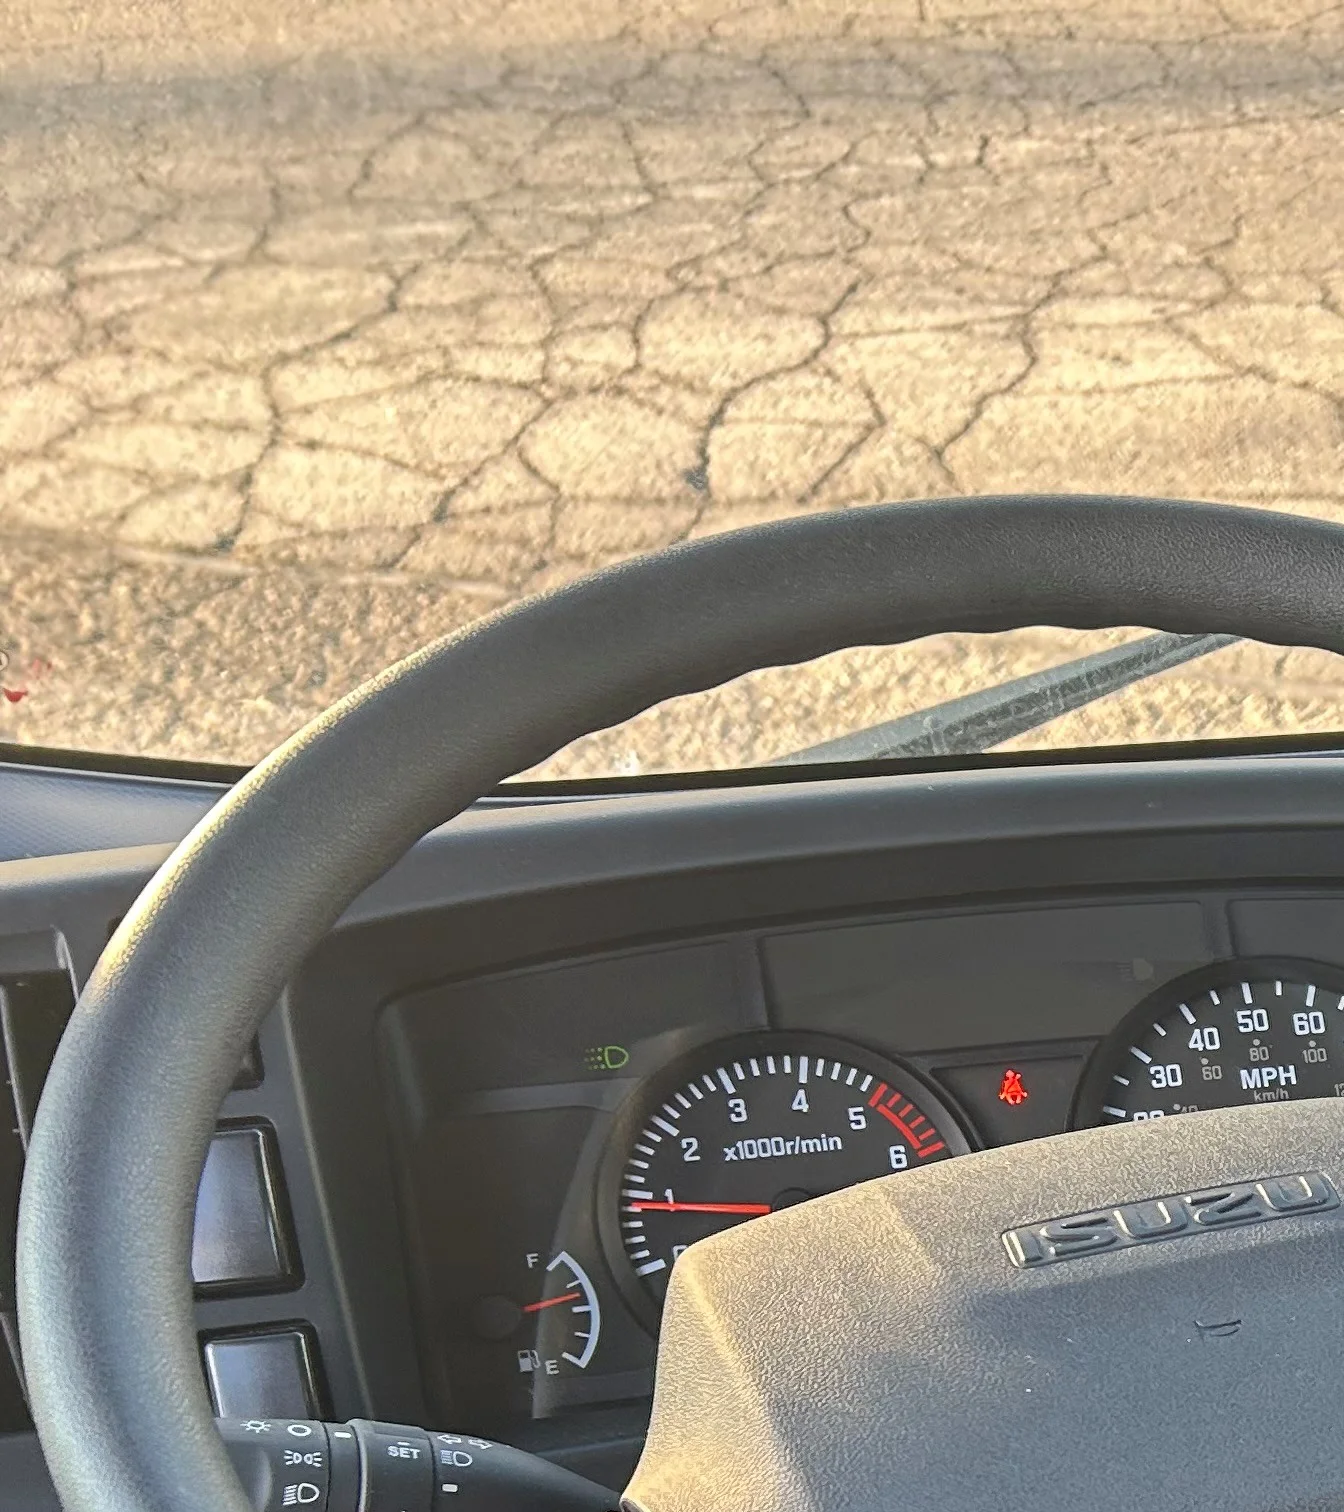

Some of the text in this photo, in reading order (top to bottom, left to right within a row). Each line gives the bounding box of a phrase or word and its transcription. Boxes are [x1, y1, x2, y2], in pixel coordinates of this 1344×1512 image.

[1237, 1009, 1270, 1033] 50
[1293, 1011, 1326, 1035] 60
[1188, 1027, 1220, 1051] 40
[1250, 1047, 1270, 1062] 80
[1302, 1048, 1327, 1063] 100
[1150, 1064, 1182, 1088] 30
[1202, 1066, 1222, 1080] 60
[1240, 1065, 1297, 1090] MPH
[792, 1089, 809, 1112] 4
[1254, 1088, 1289, 1101] km/h
[730, 1099, 747, 1123] 3
[848, 1107, 867, 1130] 5
[681, 1137, 700, 1162] 2
[723, 1134, 842, 1162] x1000r/min
[889, 1145, 908, 1169] 6
[664, 1188, 674, 1211] 1
[1003, 1174, 1329, 1264] ISUZU
[526, 1252, 539, 1268] F
[545, 1360, 560, 1375] E
[387, 1446, 420, 1459] SET
